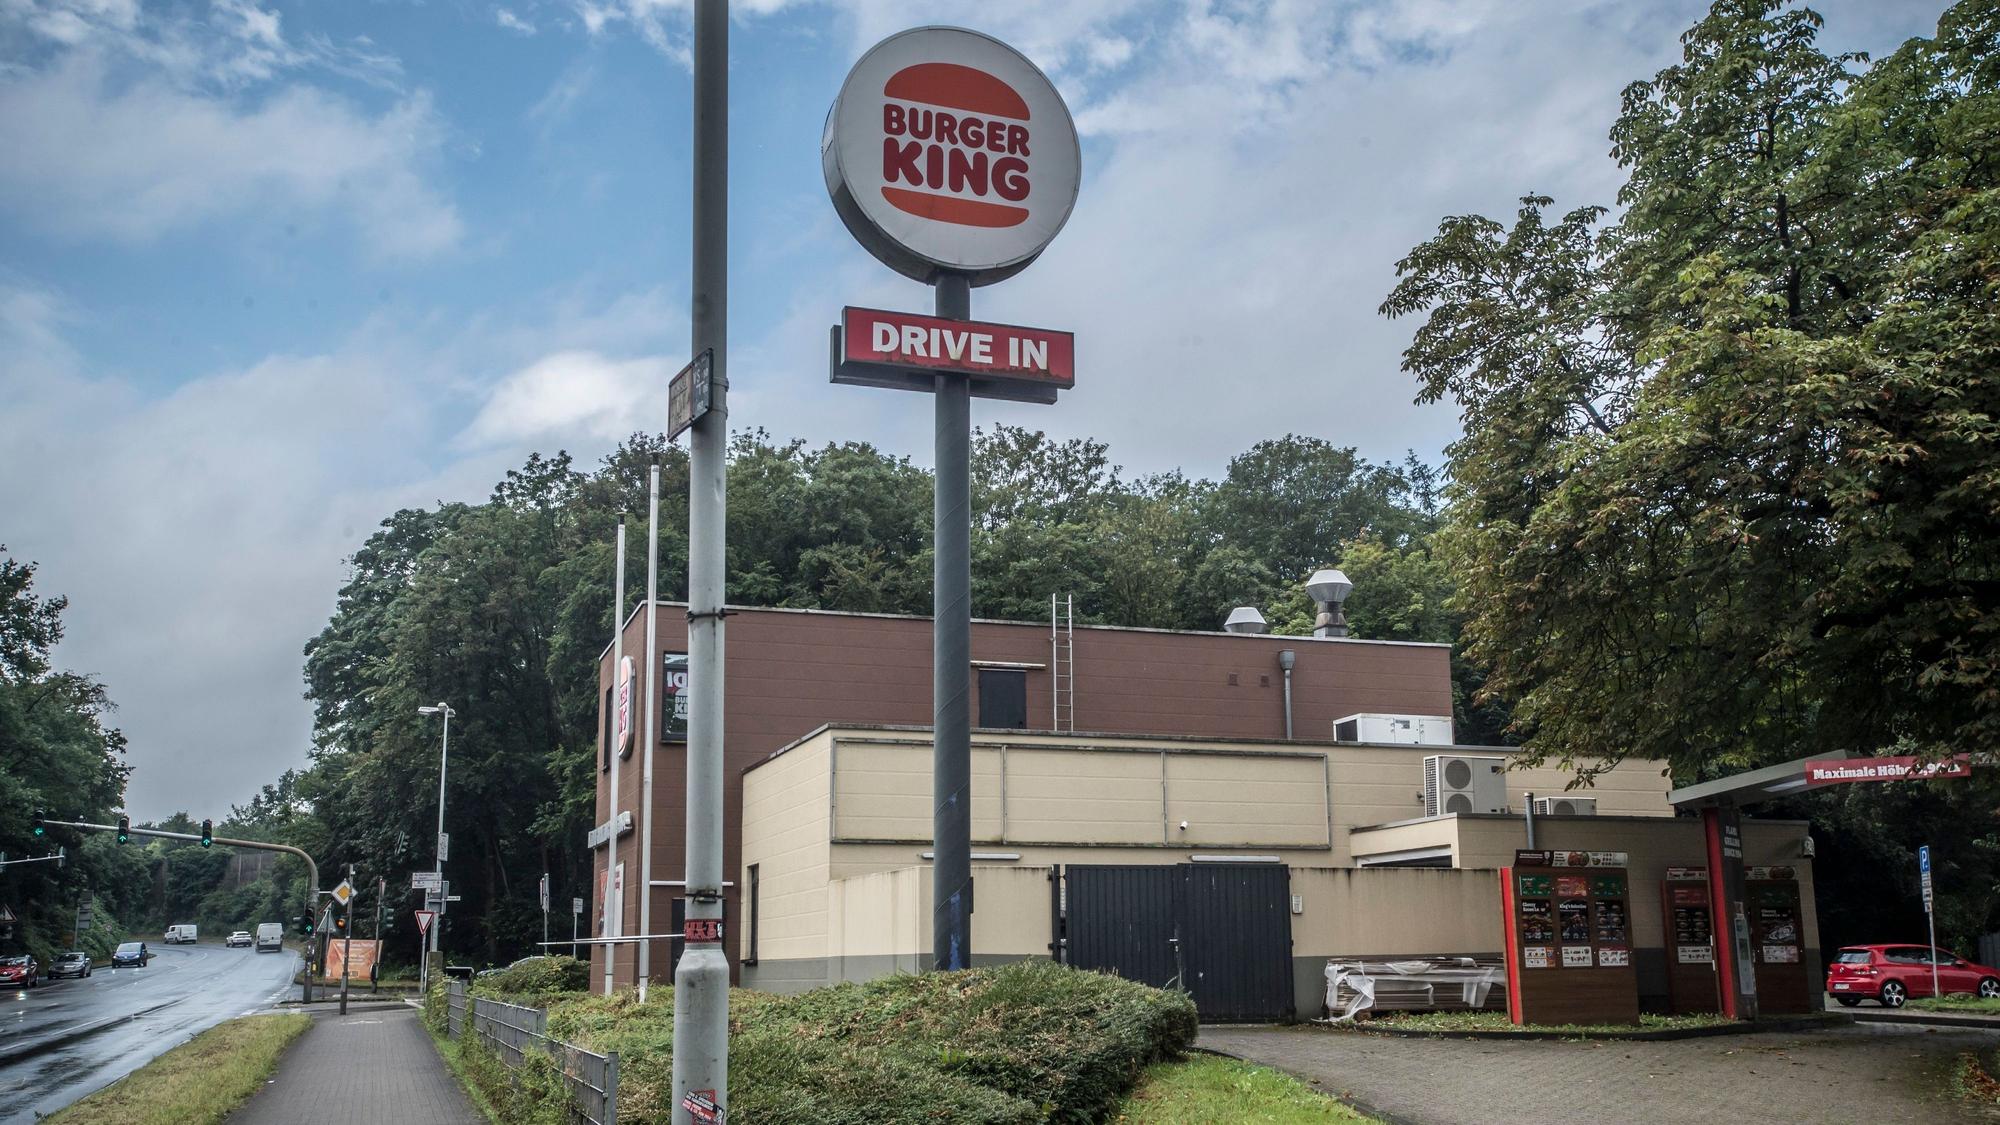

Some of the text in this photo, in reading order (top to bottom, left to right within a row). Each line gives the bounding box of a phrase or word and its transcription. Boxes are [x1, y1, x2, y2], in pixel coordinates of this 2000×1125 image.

[883, 103, 1031, 157] BURGER
[883, 138, 1031, 201] KING
[872, 321, 1048, 370] DRIVE IN
[1813, 766, 1876, 780] Maximale
[1921, 850, 1927, 870] P
